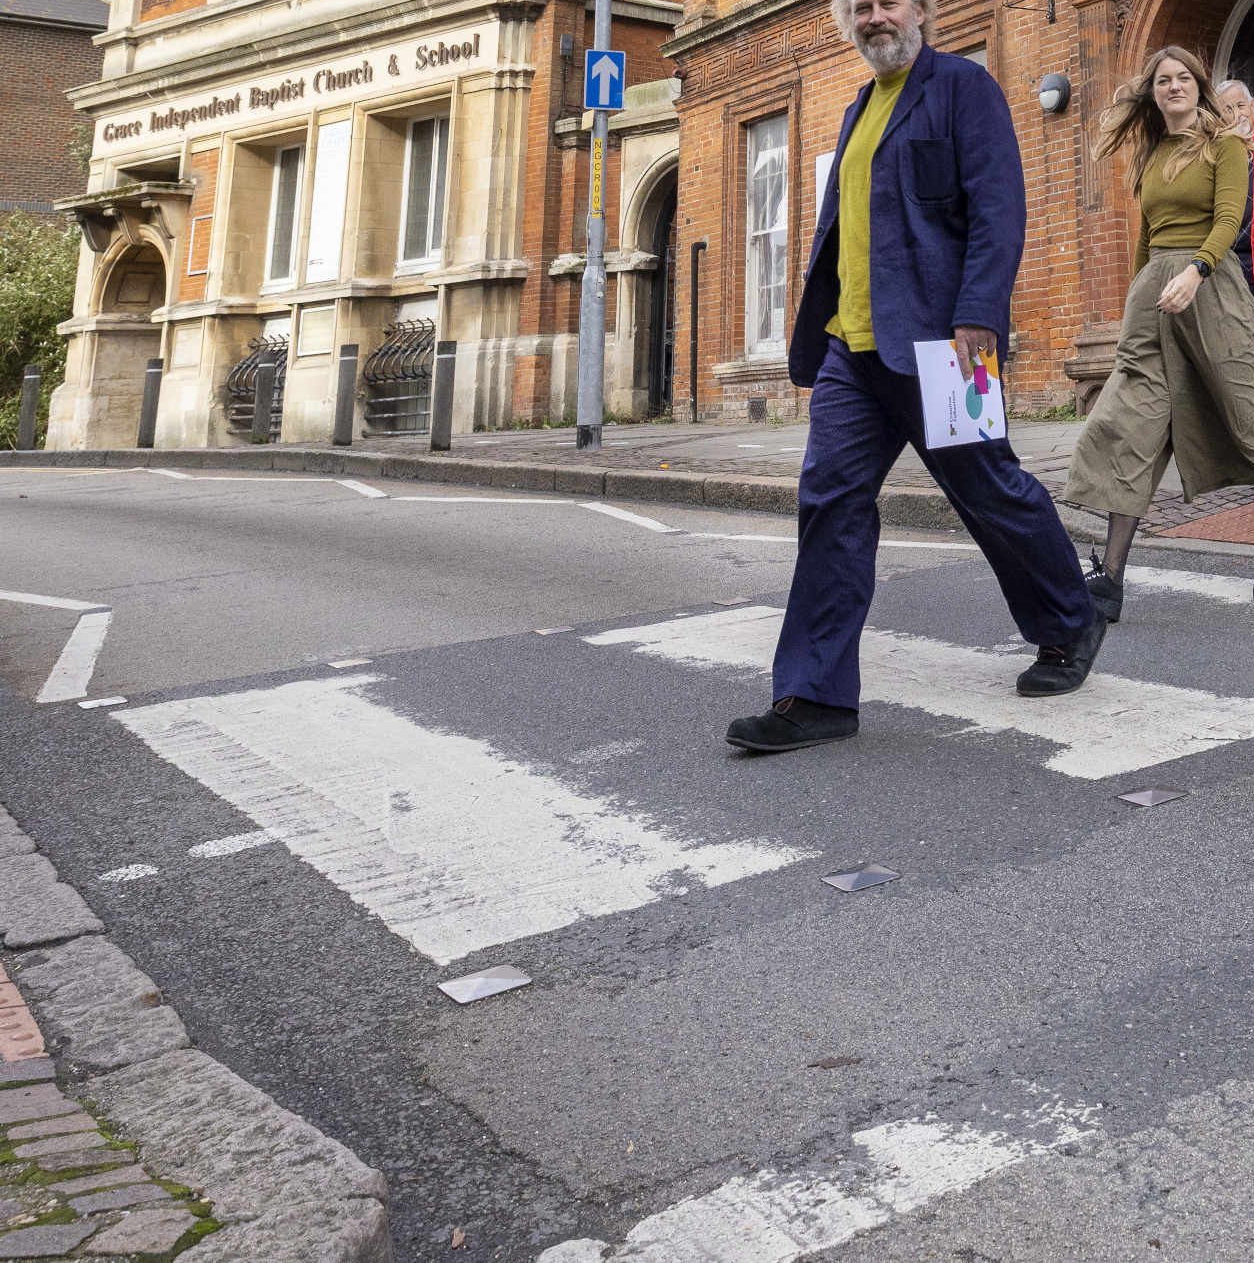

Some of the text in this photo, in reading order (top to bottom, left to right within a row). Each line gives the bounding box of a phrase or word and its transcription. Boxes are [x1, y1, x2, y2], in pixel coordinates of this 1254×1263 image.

[103, 32, 480, 143] Grace Independent Baptist Church & School
